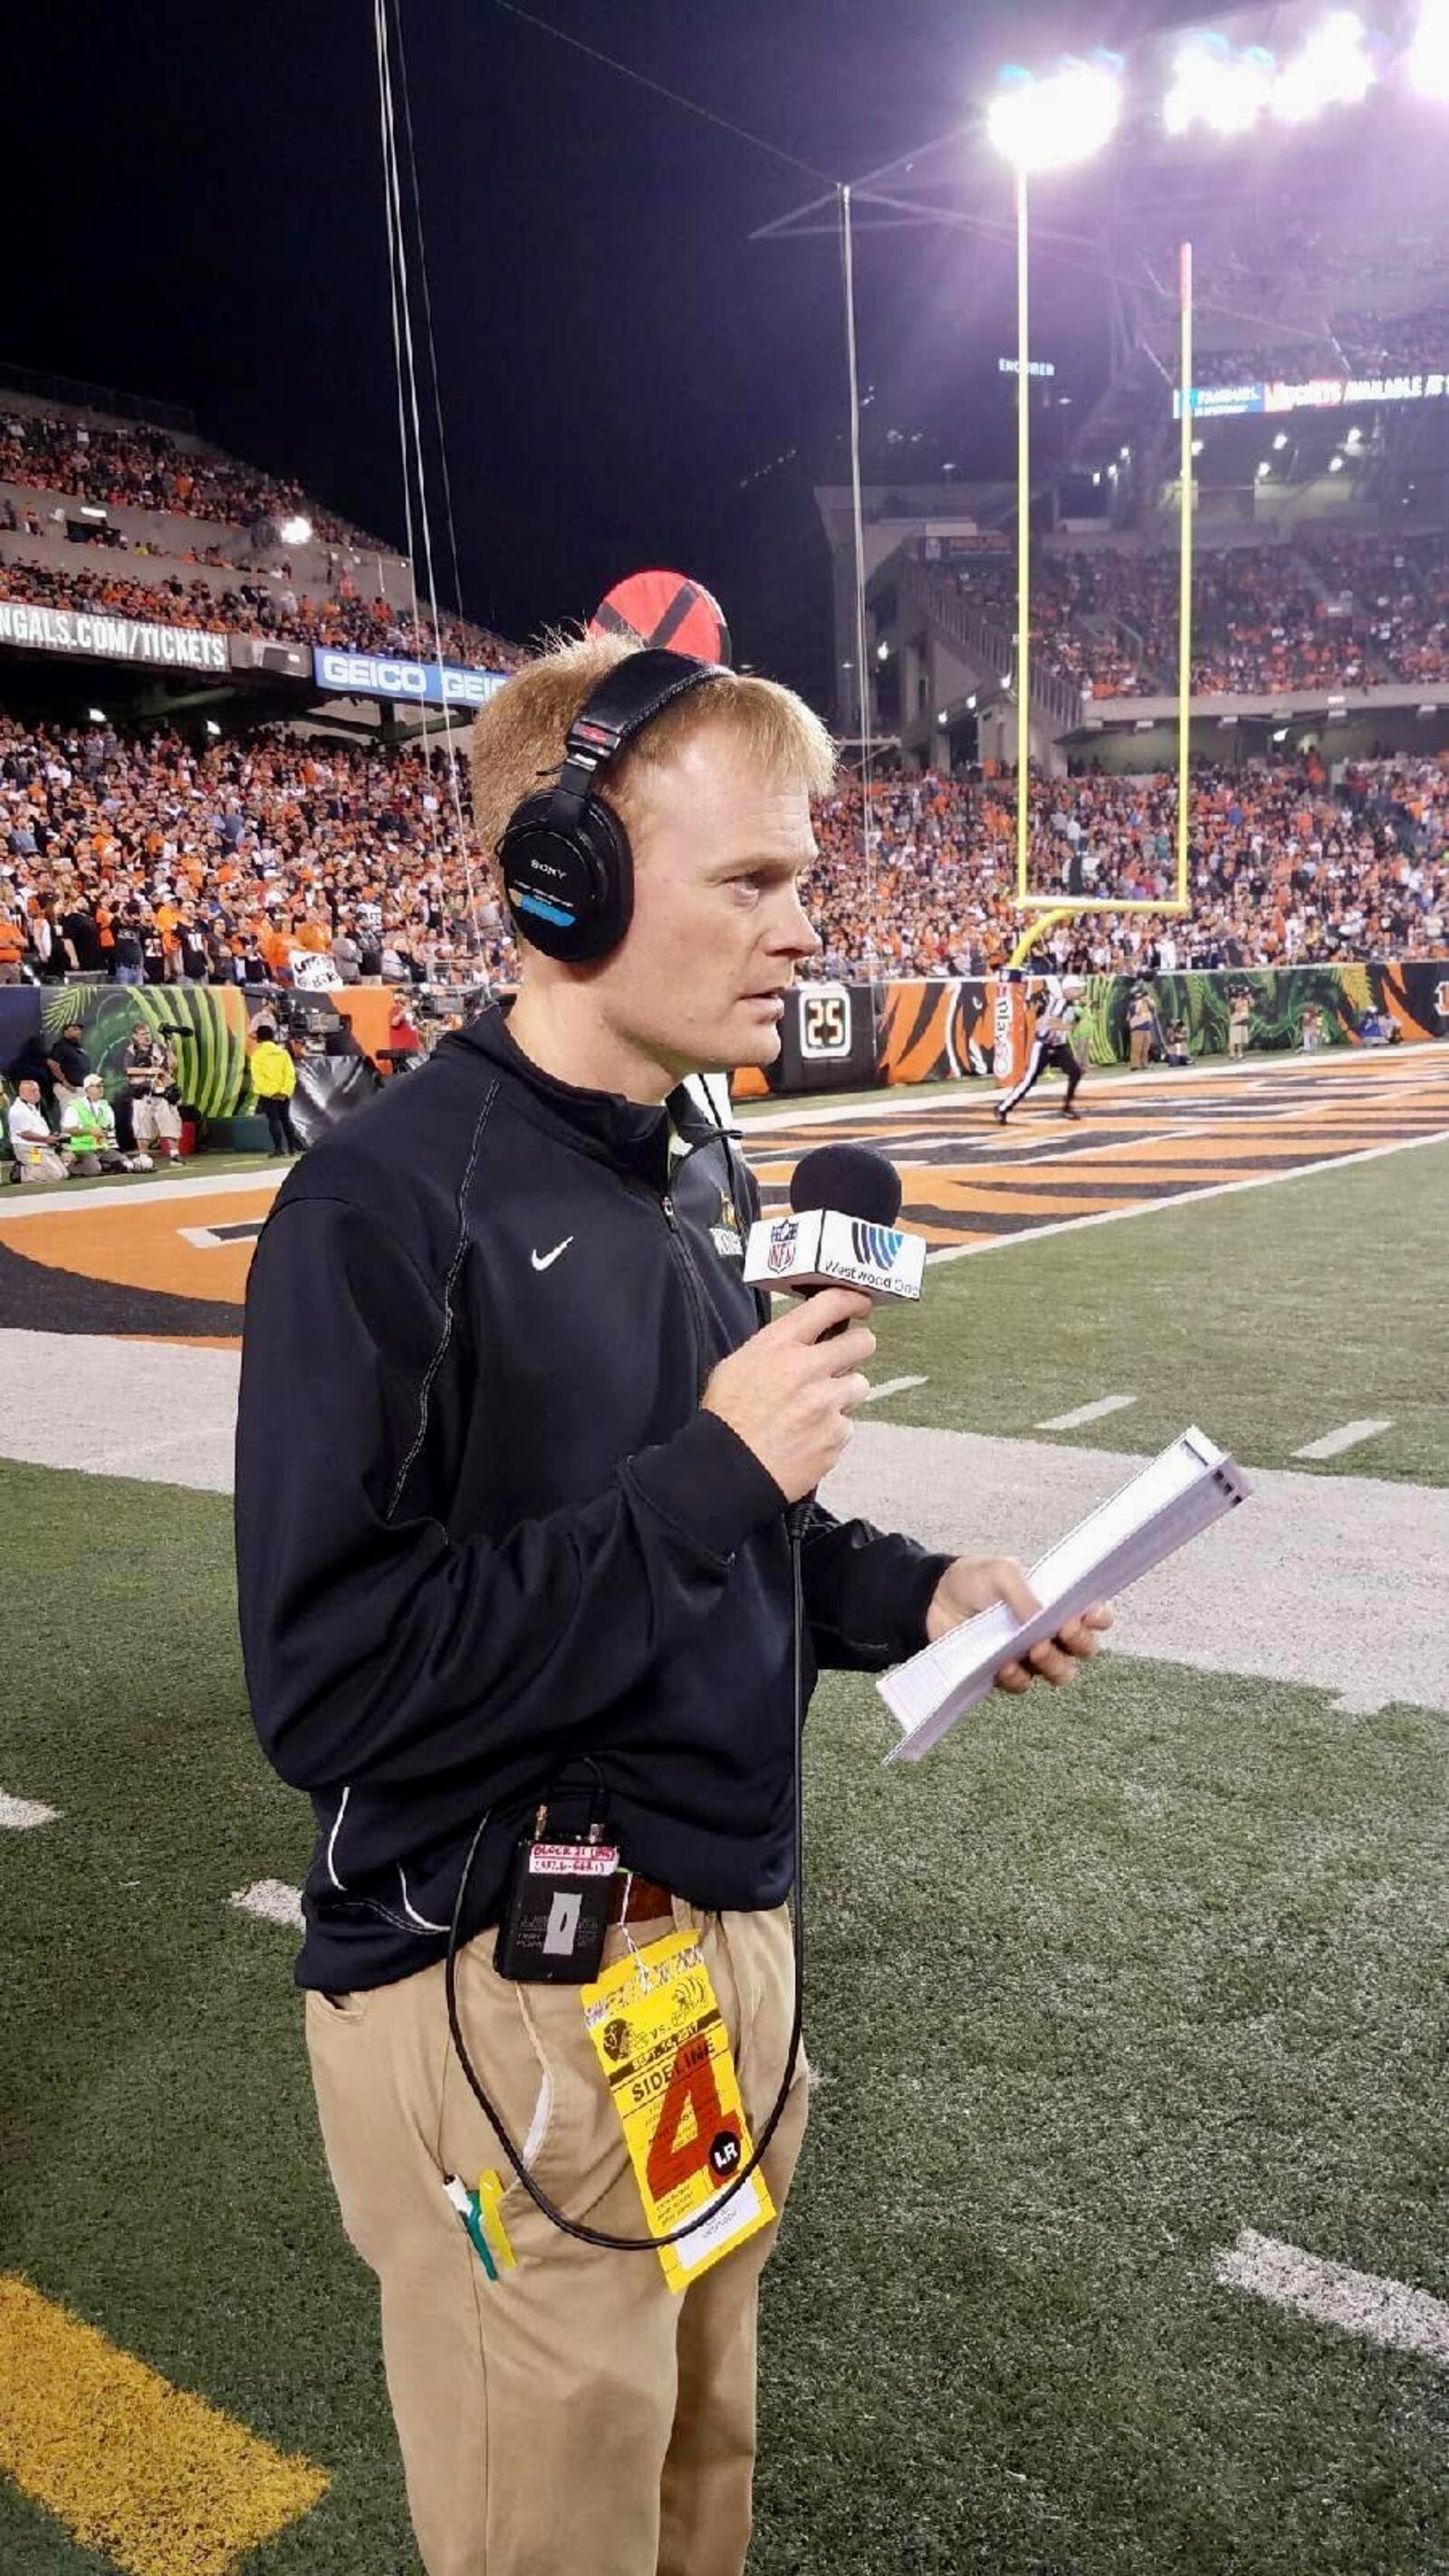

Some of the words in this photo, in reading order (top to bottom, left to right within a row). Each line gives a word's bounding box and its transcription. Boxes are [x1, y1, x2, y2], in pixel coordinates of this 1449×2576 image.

[323, 655, 427, 693] GEICO
[442, 670, 507, 701] GEI
[530, 859, 568, 879] SONY
[808, 999, 843, 1045] 25
[632, 2035, 716, 2101] SIDELINE
[646, 2033, 744, 2203] 4
[714, 2141, 738, 2168] LR
